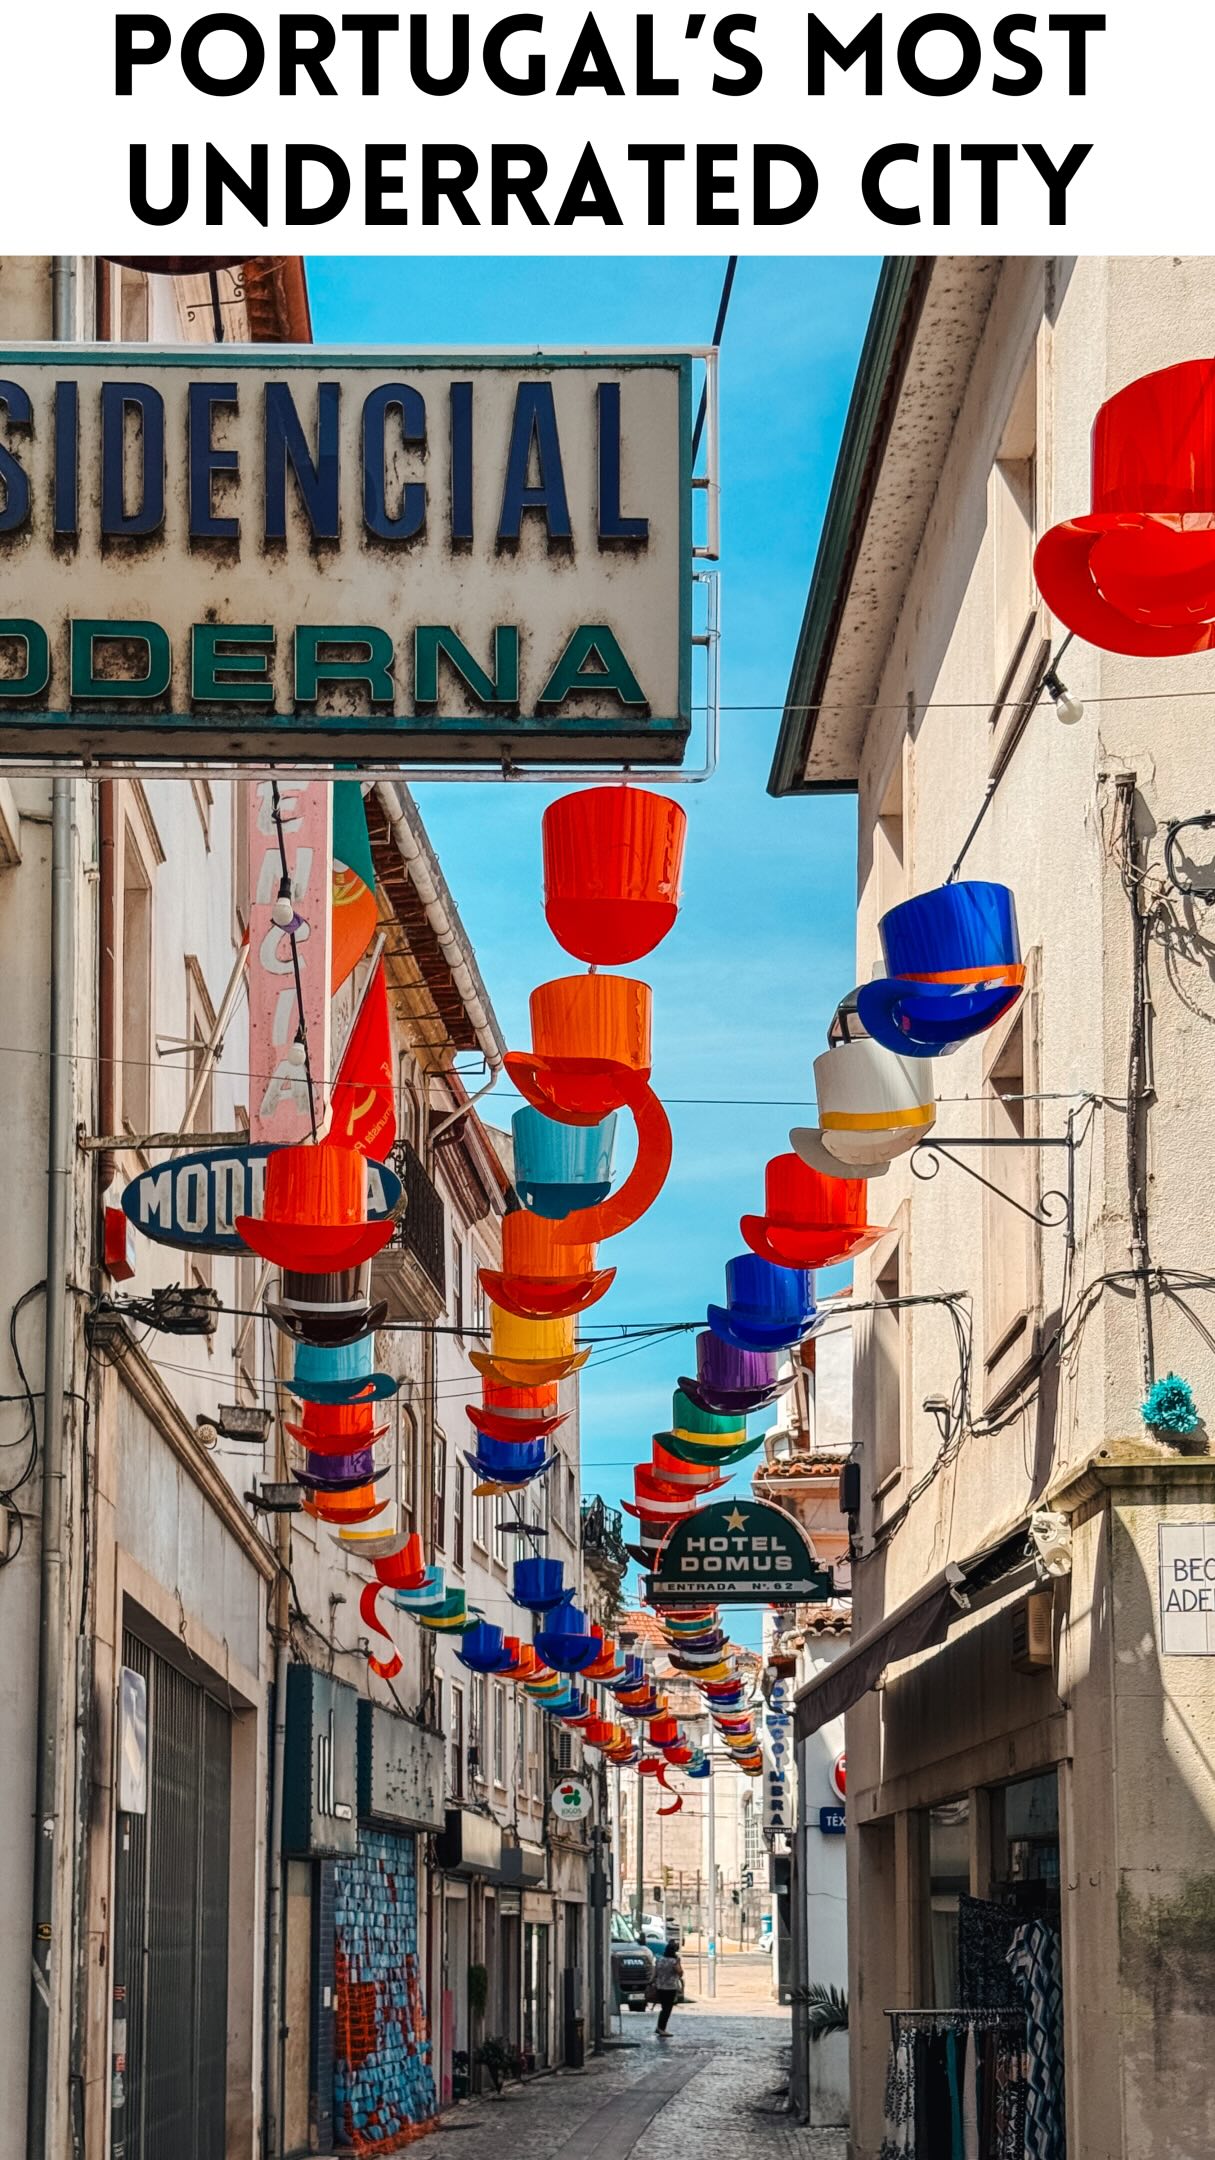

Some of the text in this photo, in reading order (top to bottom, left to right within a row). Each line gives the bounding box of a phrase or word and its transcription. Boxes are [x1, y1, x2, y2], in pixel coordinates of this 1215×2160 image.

[139, 1158, 388, 1235] MODA
[687, 1536, 786, 1552] HOTEL
[681, 1556, 793, 1572] DOMUS
[667, 1583, 736, 1591] ENTRADA
